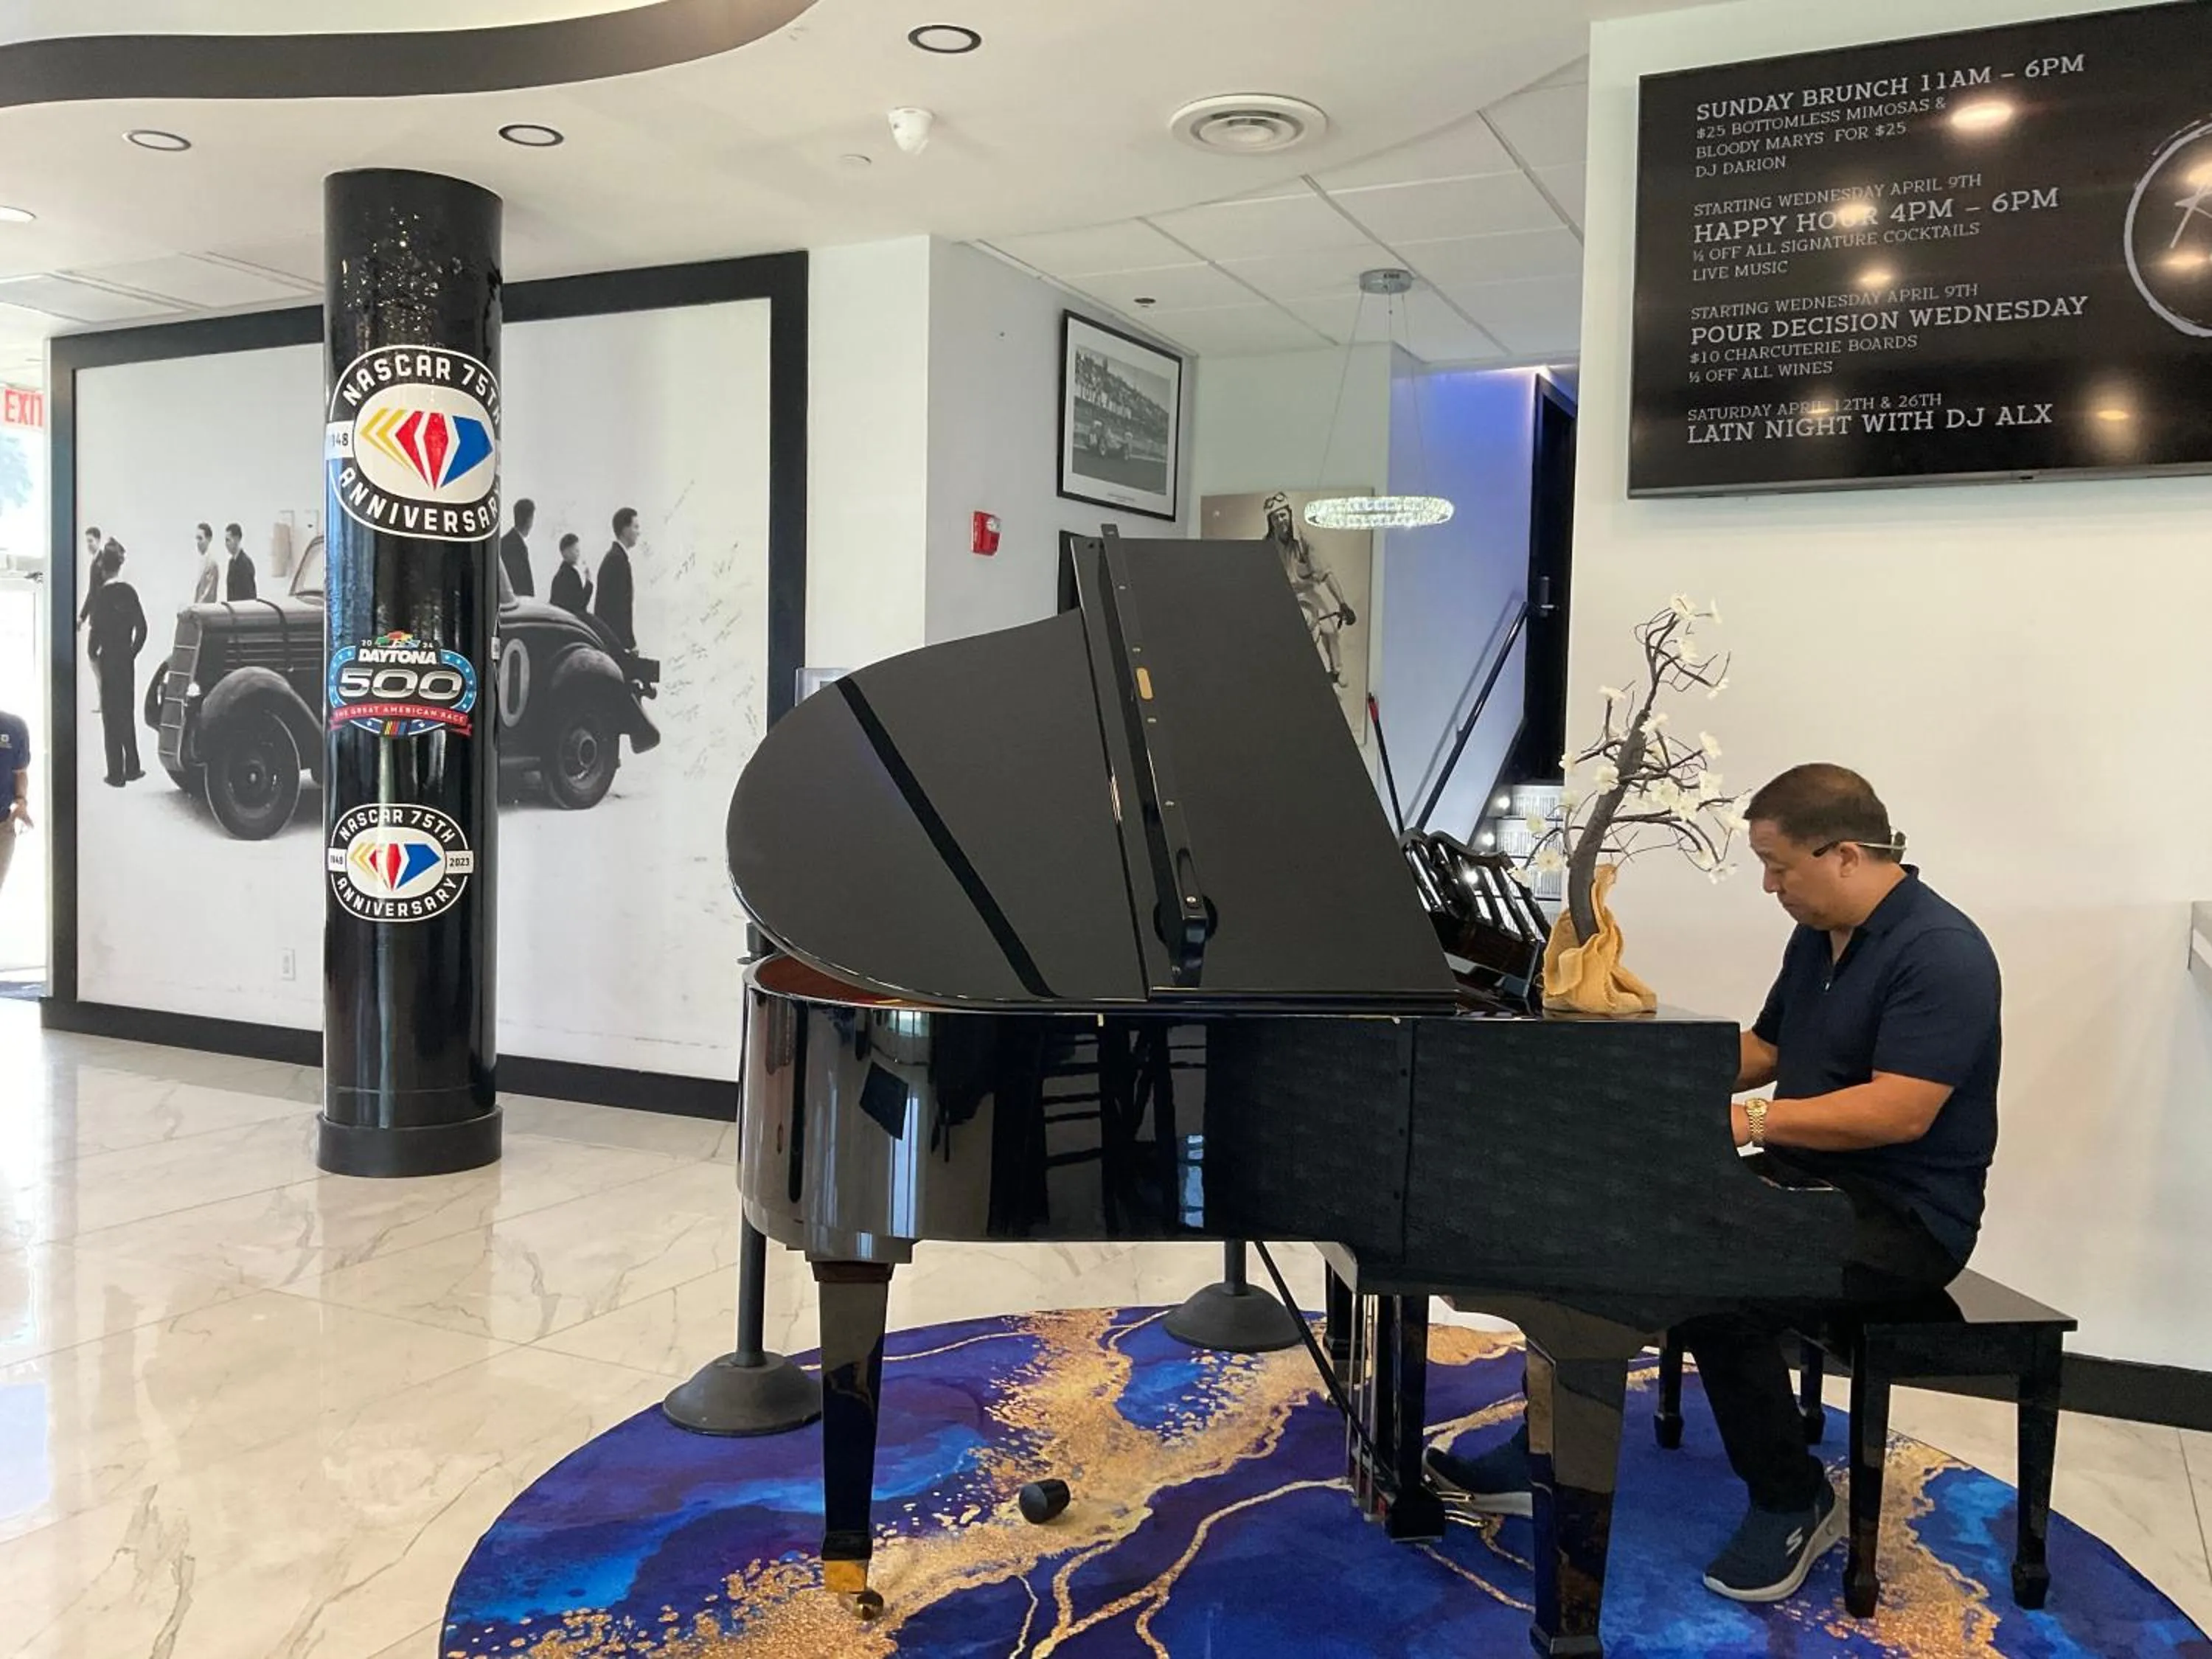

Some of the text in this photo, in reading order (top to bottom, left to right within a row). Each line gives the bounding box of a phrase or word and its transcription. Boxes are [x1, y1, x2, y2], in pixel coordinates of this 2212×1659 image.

[1697, 92, 1794, 120] SUNDAY
[1802, 77, 1908, 108] BRUNCH
[1921, 66, 1992, 92] 11AM
[2025, 54, 2085, 78] 6PM
[1697, 96, 1947, 139] $25 BOTTOMLESS MIMOSAS &
[1697, 121, 1906, 159] BLOODY MARYS FOR $25
[1696, 155, 1787, 178] DJ DARION
[1694, 173, 1981, 218] STARTING WEDNESDAY APRIL 9TH
[1694, 215, 1787, 243] HAPPY
[1890, 198, 1954, 223] 4PM
[1992, 187, 2059, 214] 6PM
[1708, 246, 1742, 260] OFF
[1745, 243, 1776, 258] ALL
[1781, 232, 1878, 254] SIGNATURE
[1883, 222, 1981, 243] COCKTAILS
[1693, 260, 1789, 282] LIVE MUSIC
[1691, 283, 1979, 320] STARTING WEDNESDAY APRIL 9TH
[1691, 295, 2088, 345] POUR DECISION WEDNESDAY
[1690, 334, 1919, 364] $10 CHARCUTERIE BOARDS
[341, 353, 452, 407] NASCAR
[1705, 368, 1739, 383] OFF
[1742, 365, 1773, 380] ALL
[1778, 360, 1834, 378] WINES
[1688, 392, 1942, 422] SATURDAY APRIL 12TH & 26TH
[1688, 403, 2054, 444] LATN NIGHT WITH DJ ALX
[358, 648, 438, 665] DAYTONA
[338, 667, 463, 700] 500
[351, 706, 380, 717] GREAT
[383, 706, 438, 720] AMERICAN
[440, 711, 465, 723] RACE
[338, 808, 456, 844] NASCAR 75TH
[449, 857, 470, 868] 2023
[337, 876, 458, 917] ANNIVERSARY
